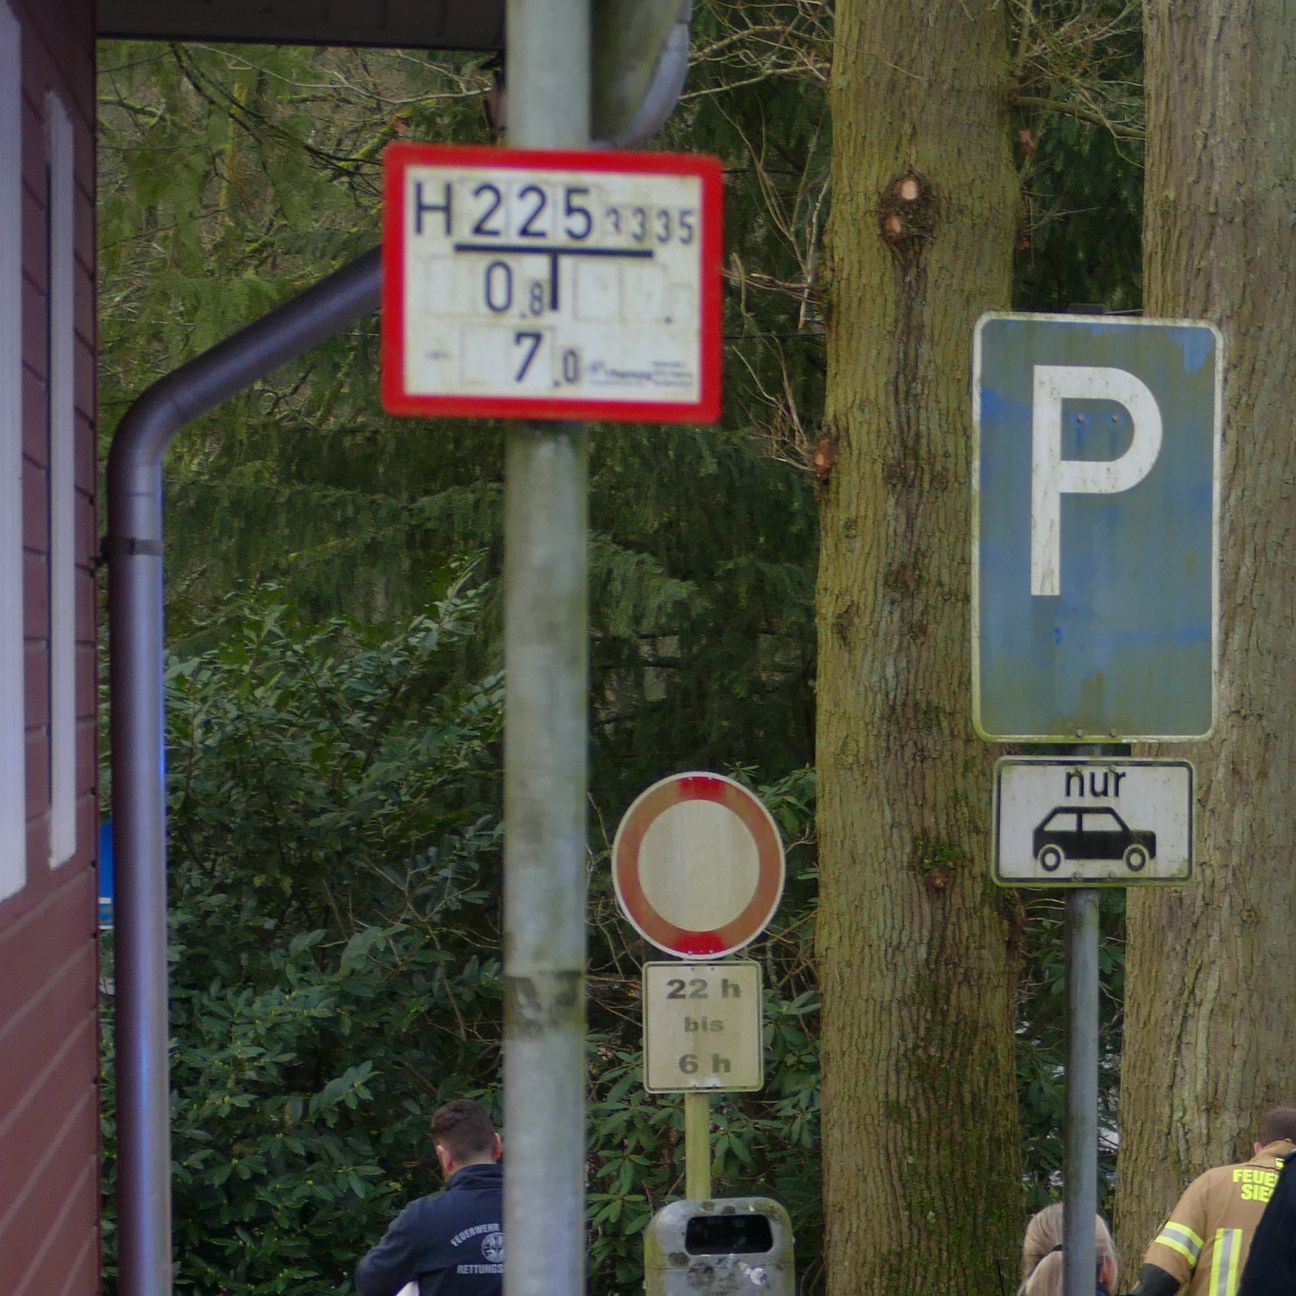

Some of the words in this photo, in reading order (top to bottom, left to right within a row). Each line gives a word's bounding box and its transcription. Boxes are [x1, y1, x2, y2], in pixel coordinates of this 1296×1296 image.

[1030, 364, 1163, 596] P
[1064, 766, 1126, 799] nur
[667, 978, 708, 999] 22
[722, 979, 740, 998] h
[684, 1017, 724, 1032] bis
[679, 1055, 698, 1073] 6
[713, 1054, 731, 1073] h
[1232, 1167, 1280, 1188] FEUE
[1240, 1183, 1274, 1203] SIE
